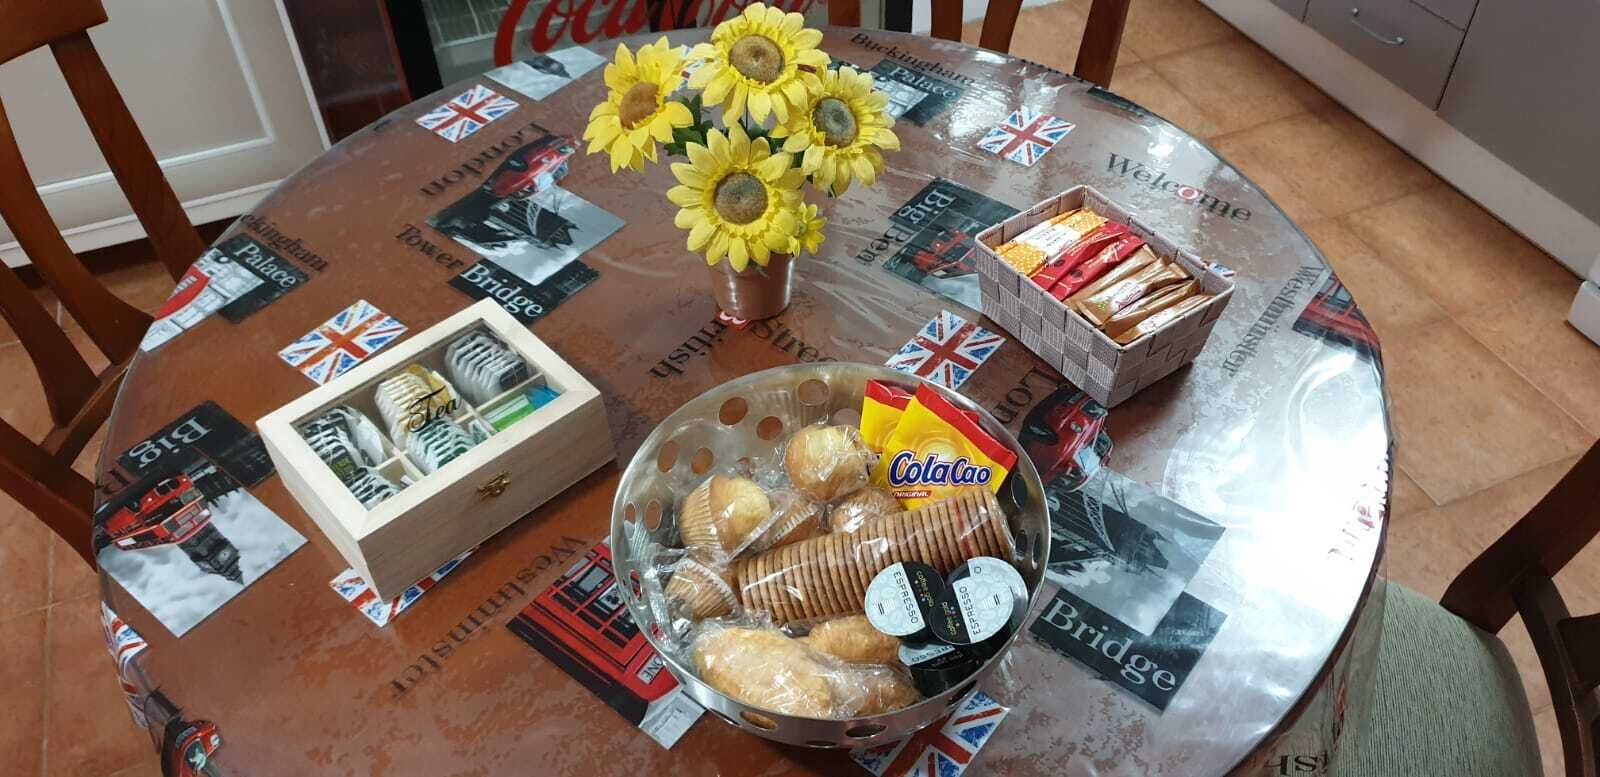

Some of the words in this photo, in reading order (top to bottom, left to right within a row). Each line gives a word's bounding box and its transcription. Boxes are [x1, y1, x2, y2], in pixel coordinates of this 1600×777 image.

[889, 67, 956, 98] Palace
[420, 122, 552, 196] London
[898, 190, 958, 225] Big
[1107, 153, 1252, 222] Welcome
[233, 243, 297, 288] Palace
[396, 223, 464, 270] Tower
[855, 222, 917, 266] Ben
[460, 263, 544, 317] Bridge
[1221, 264, 1325, 378] Westminster
[406, 385, 462, 432] Tea
[128, 416, 213, 469] Big
[389, 535, 589, 698] Westminster
[893, 570, 919, 625] ESPRESSO
[959, 586, 981, 635] ESPRESSO
[1040, 599, 1177, 693] Bridge
